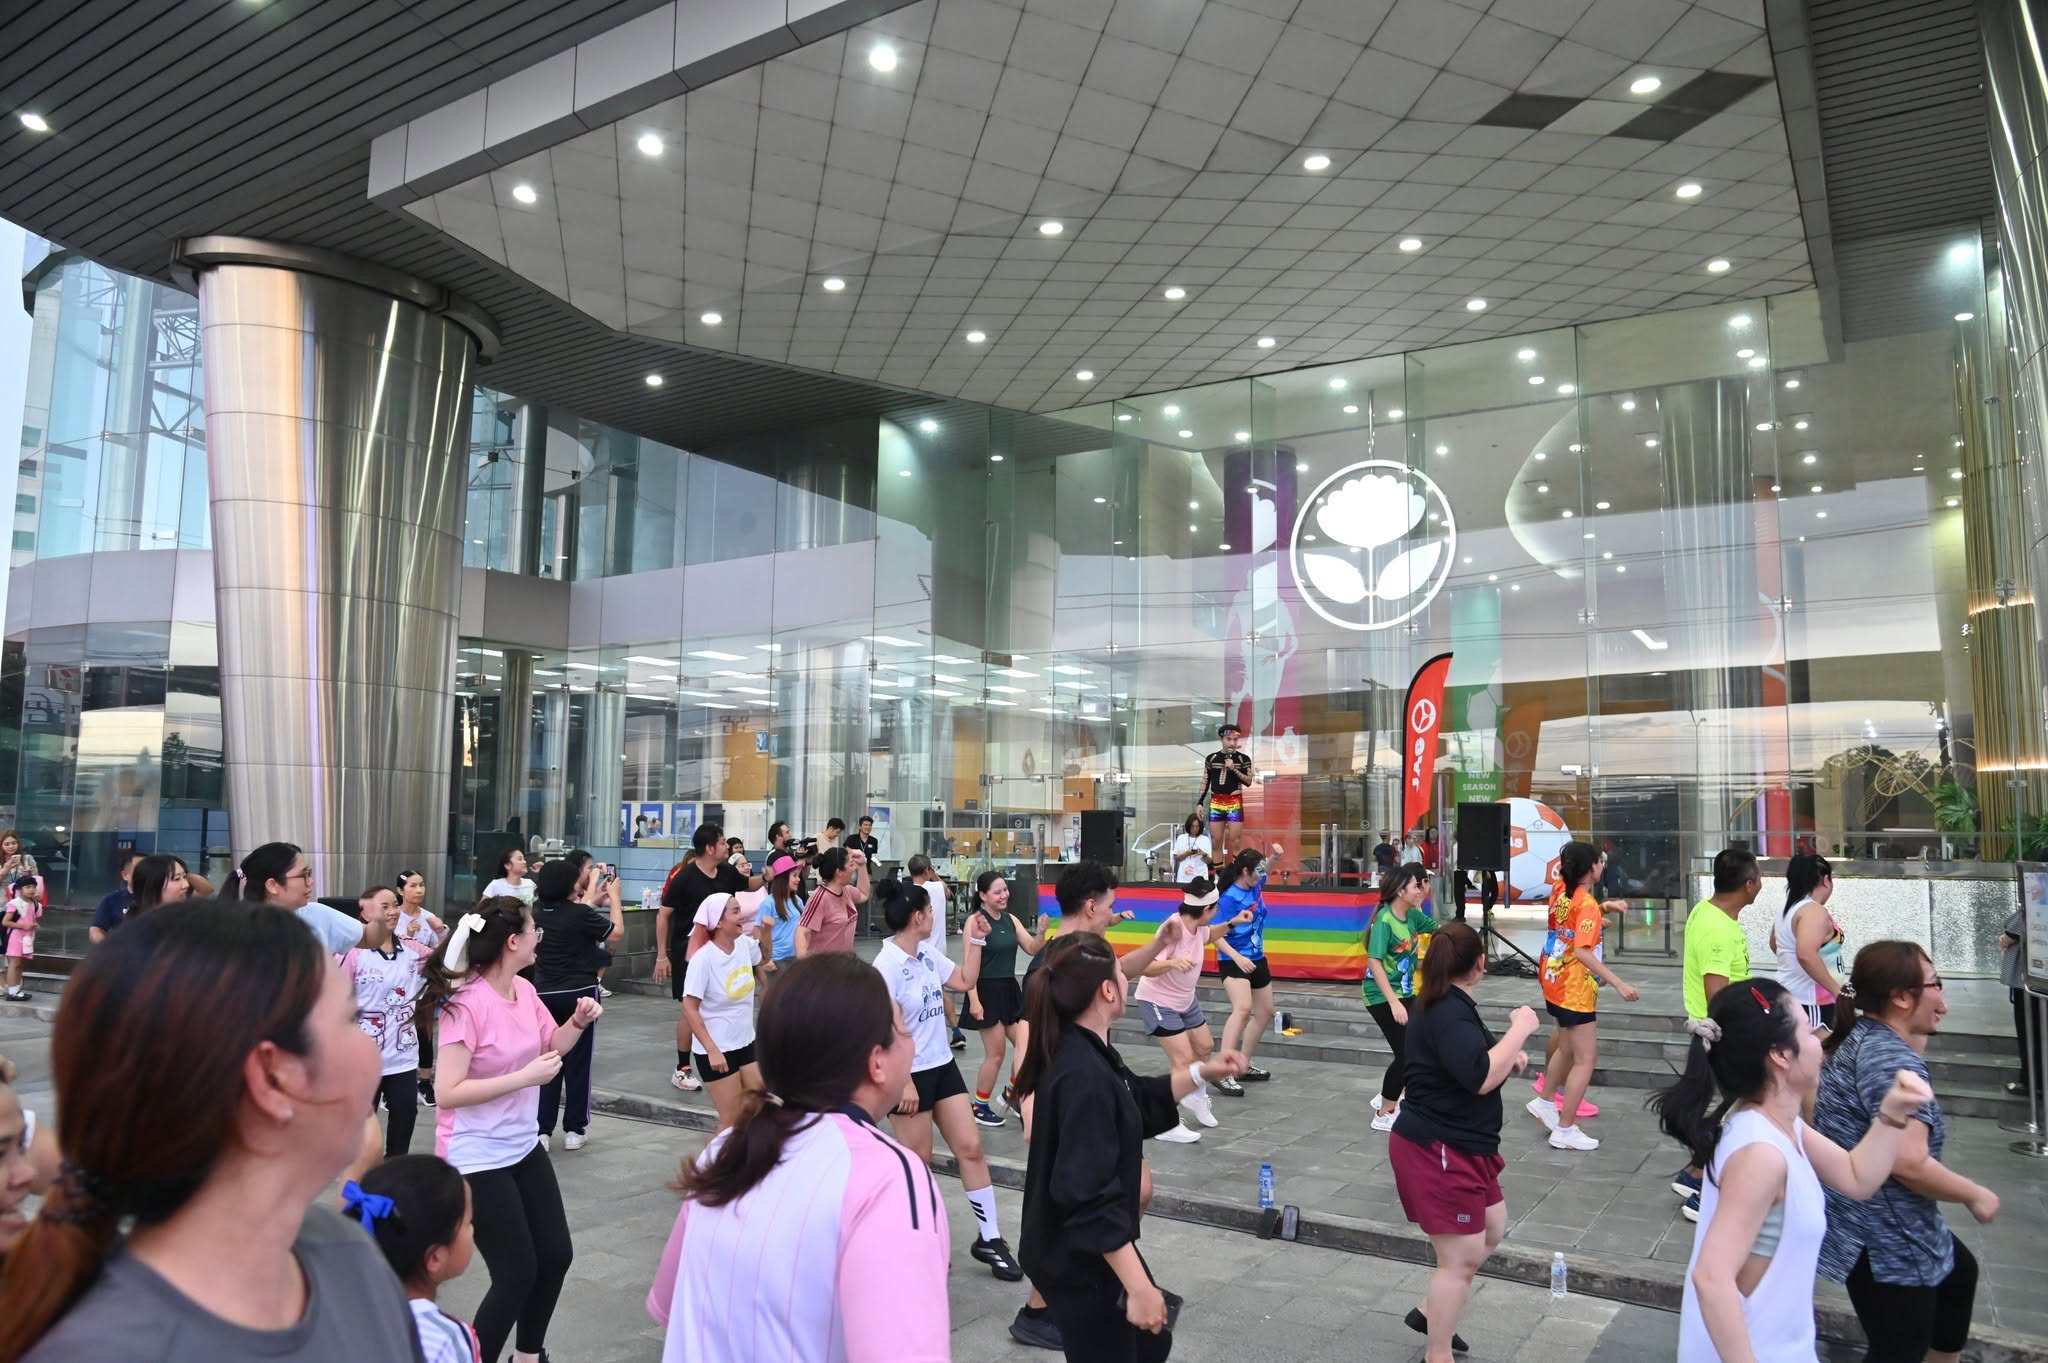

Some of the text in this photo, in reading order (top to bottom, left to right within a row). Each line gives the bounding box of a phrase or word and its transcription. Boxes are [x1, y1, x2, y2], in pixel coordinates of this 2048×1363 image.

[1468, 771, 1490, 779] NEW
[1462, 783, 1497, 791] SEASON
[1468, 795, 1491, 803] NEW
